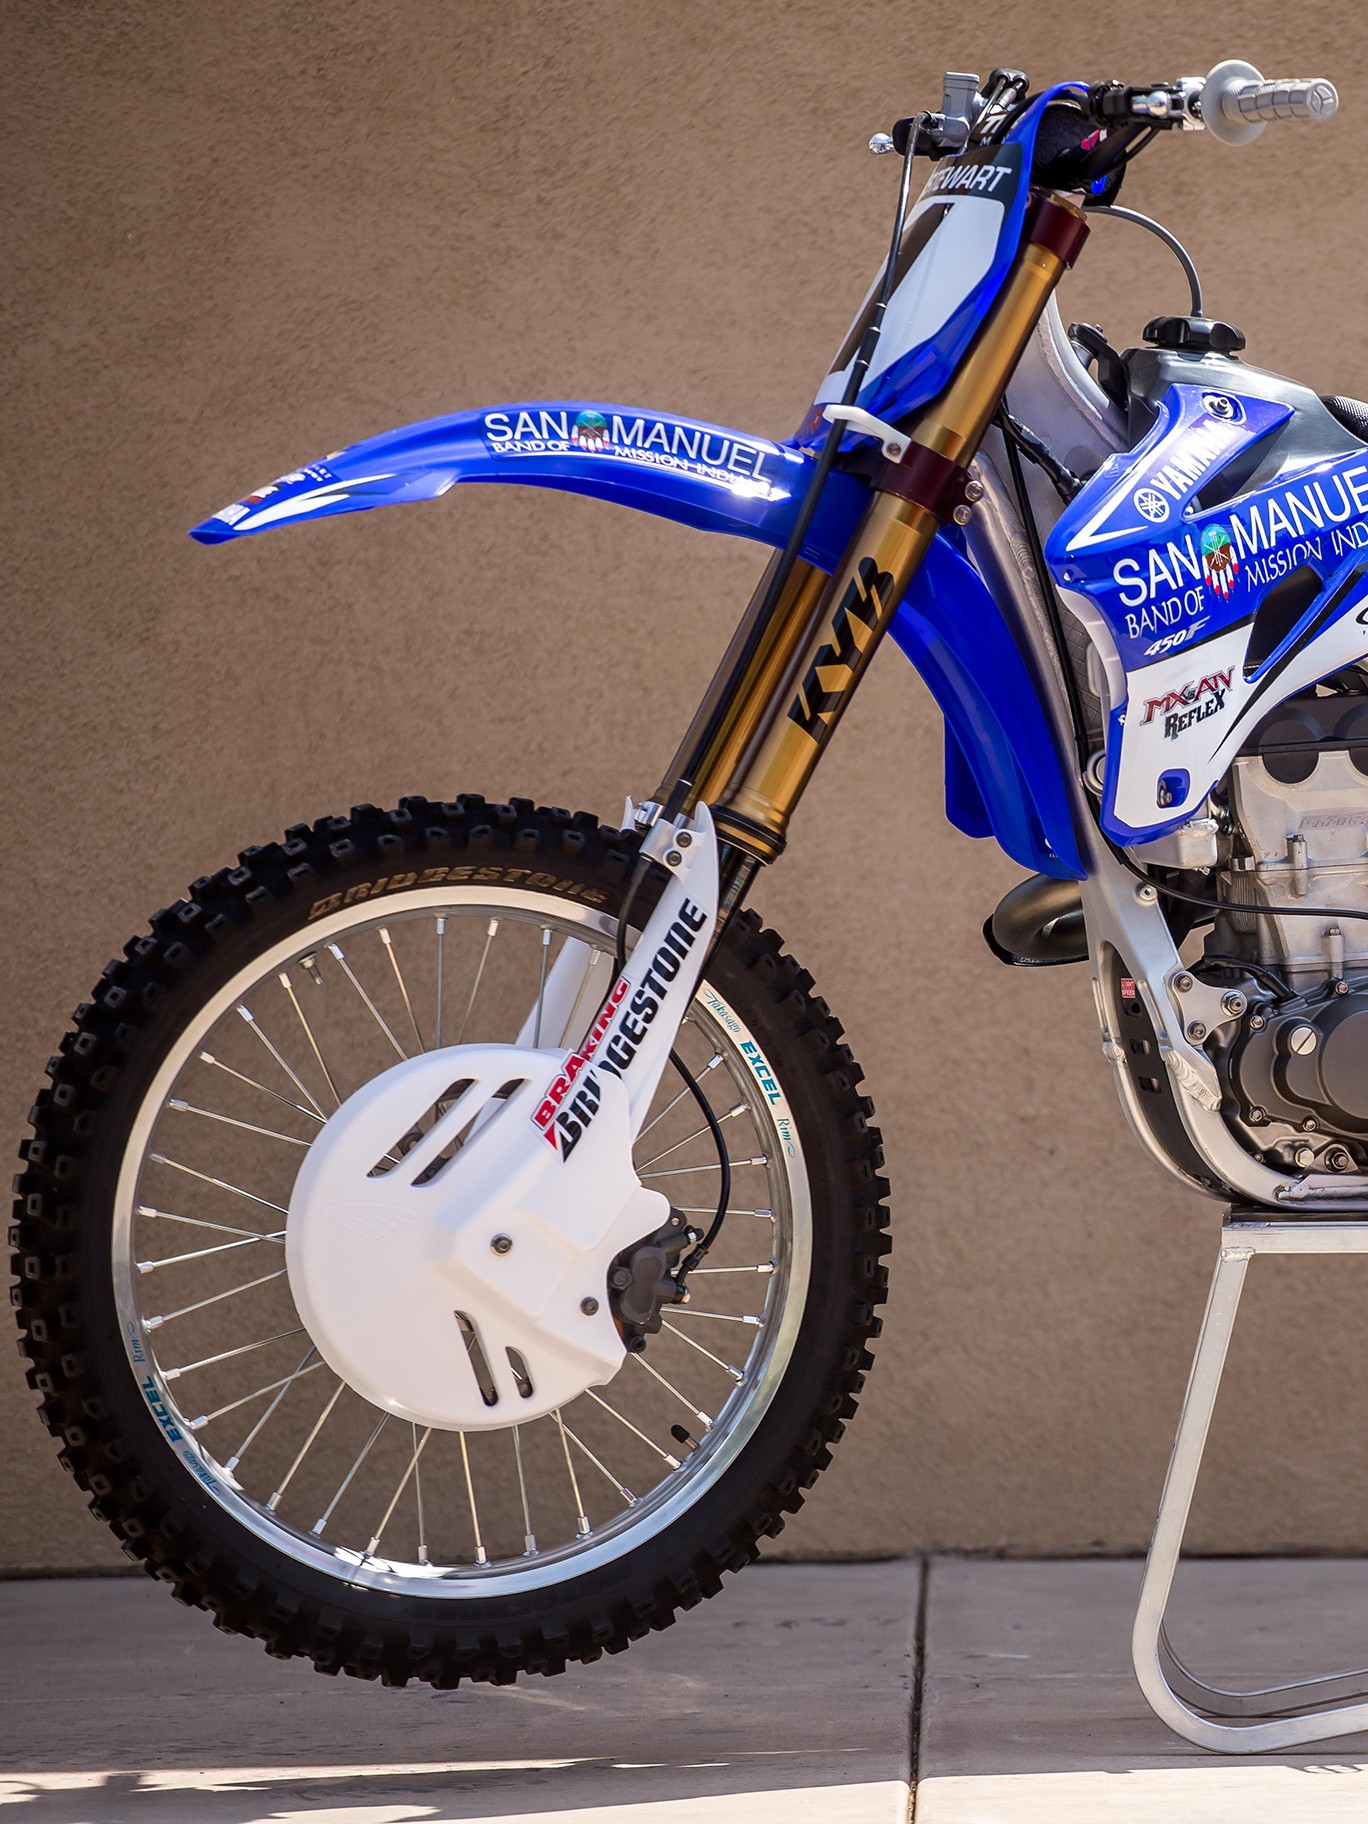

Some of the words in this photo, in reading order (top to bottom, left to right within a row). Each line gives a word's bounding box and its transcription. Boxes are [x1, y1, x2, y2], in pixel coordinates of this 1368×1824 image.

[484, 411, 568, 442] SAN
[611, 415, 772, 484] MANUEL
[492, 441, 545, 453] BAND
[546, 440, 571, 451] OF
[615, 445, 688, 470] MISSION
[697, 462, 772, 497] INDI
[1112, 533, 1201, 607] SAN
[1125, 597, 1183, 639] BAND
[1184, 585, 1206, 616] OF
[1244, 535, 1323, 593] MISSION
[787, 556, 895, 742] KYB
[1143, 615, 1211, 656] 450F
[1140, 680, 1194, 726] MX
[1194, 665, 1235, 703] ATV
[308, 865, 609, 920] BRIDGESTONE
[533, 977, 630, 1129] BRAKING
[543, 897, 708, 1163] BRIDGESTONE
[704, 988, 742, 1034] Takasago
[740, 1040, 782, 1106] EXCEL
[777, 1117, 796, 1159] Rim
[127, 1320, 146, 1363] Rim
[142, 1375, 184, 1443] EXCEL
[183, 1450, 221, 1496] Takasago
